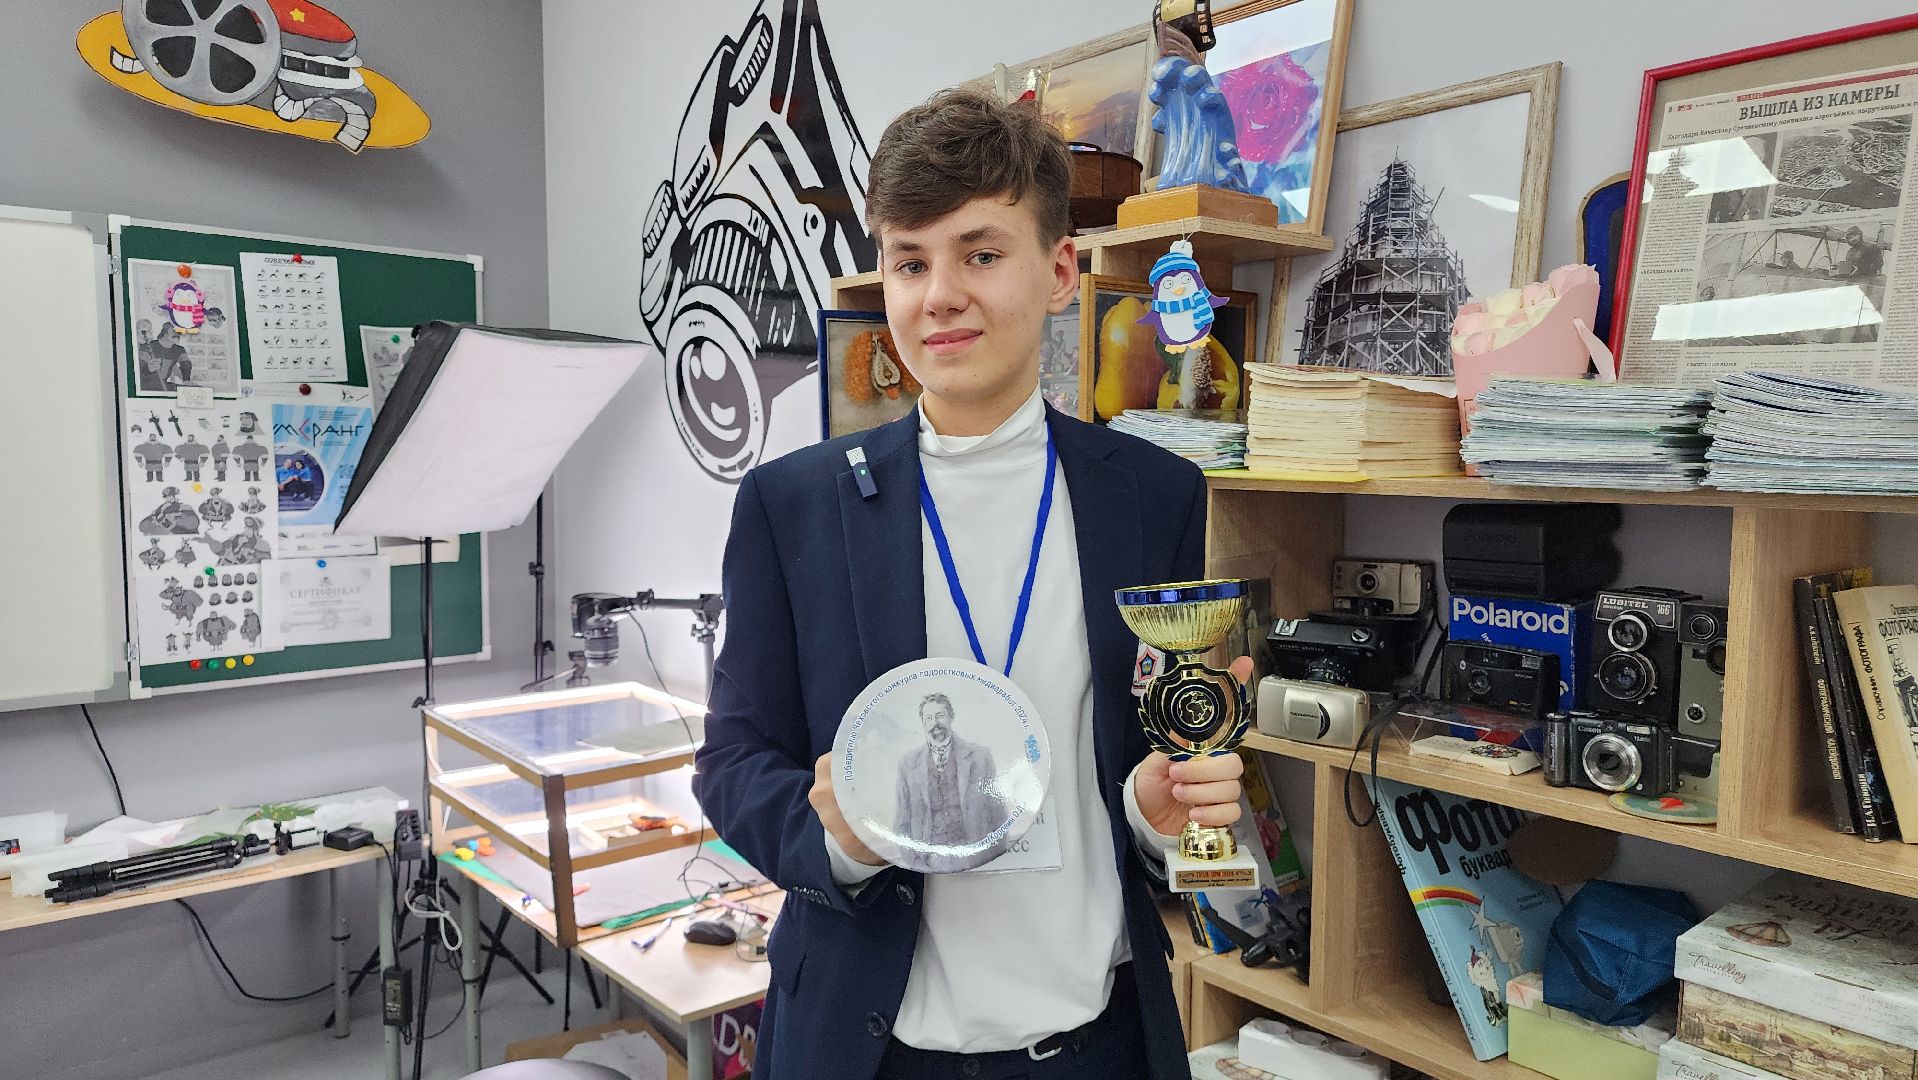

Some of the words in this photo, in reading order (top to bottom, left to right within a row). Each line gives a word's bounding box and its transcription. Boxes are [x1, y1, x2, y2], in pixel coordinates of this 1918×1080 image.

[1739, 99, 1799, 120] ВЫШЛА
[1802, 95, 1824, 111] ИЗ
[1827, 84, 1901, 107] КАМЕРЫ
[290, 586, 361, 599] СЕРТИФИКАТ
[1603, 597, 1649, 609] LUBITEL
[1657, 604, 1671, 616] 166
[1453, 597, 1570, 635] Polaroid
[1853, 625, 1874, 674] ФОТОГРАФА
[852, 692, 884, 729] Чеховского
[884, 673, 918, 695] конкурса
[976, 676, 1017, 707] медиаработ
[1014, 705, 1028, 724] 2024
[1578, 725, 1602, 734] Canon
[1688, 951, 1747, 985] Travelling
